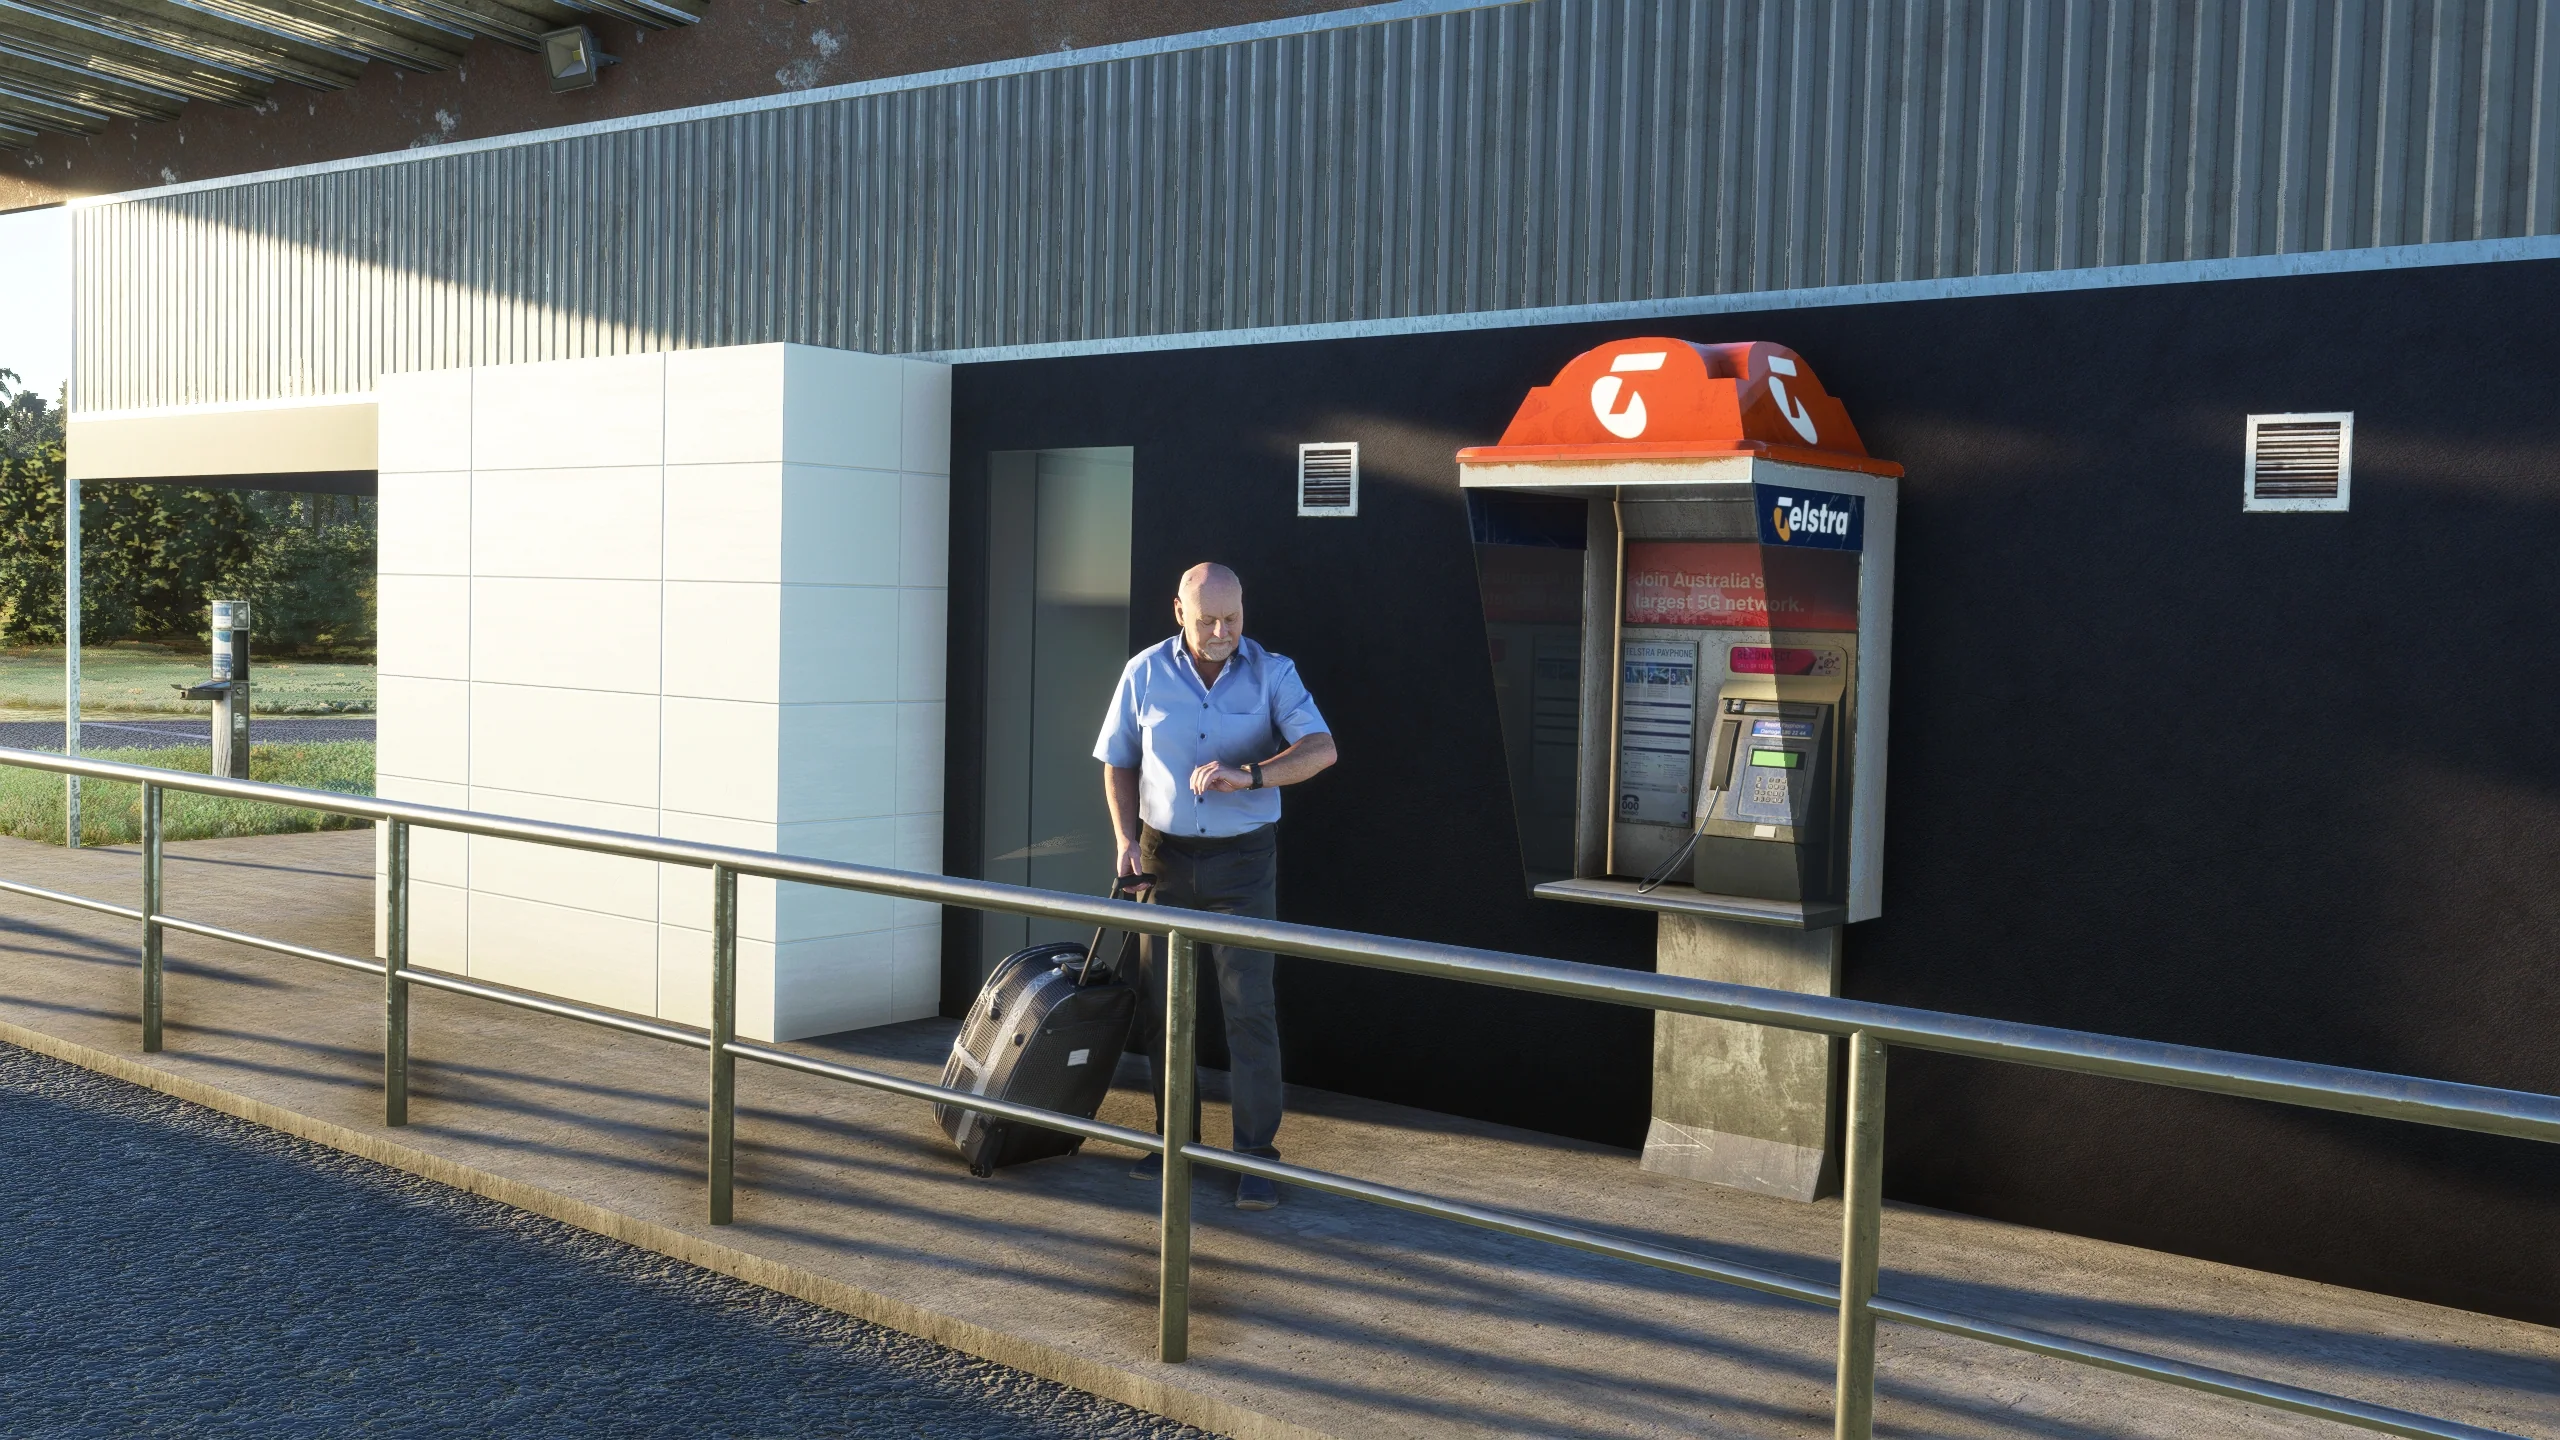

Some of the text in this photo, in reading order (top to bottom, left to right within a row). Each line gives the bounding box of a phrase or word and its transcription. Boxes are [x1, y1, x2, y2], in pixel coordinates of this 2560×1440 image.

[1773, 496, 1849, 542] Telstra
[1635, 571, 1765, 589] Join Australia's
[1635, 593, 1692, 614] largest
[1697, 594, 1720, 611] 5G
[1626, 647, 1693, 659] TELSTRA PAYPHONE
